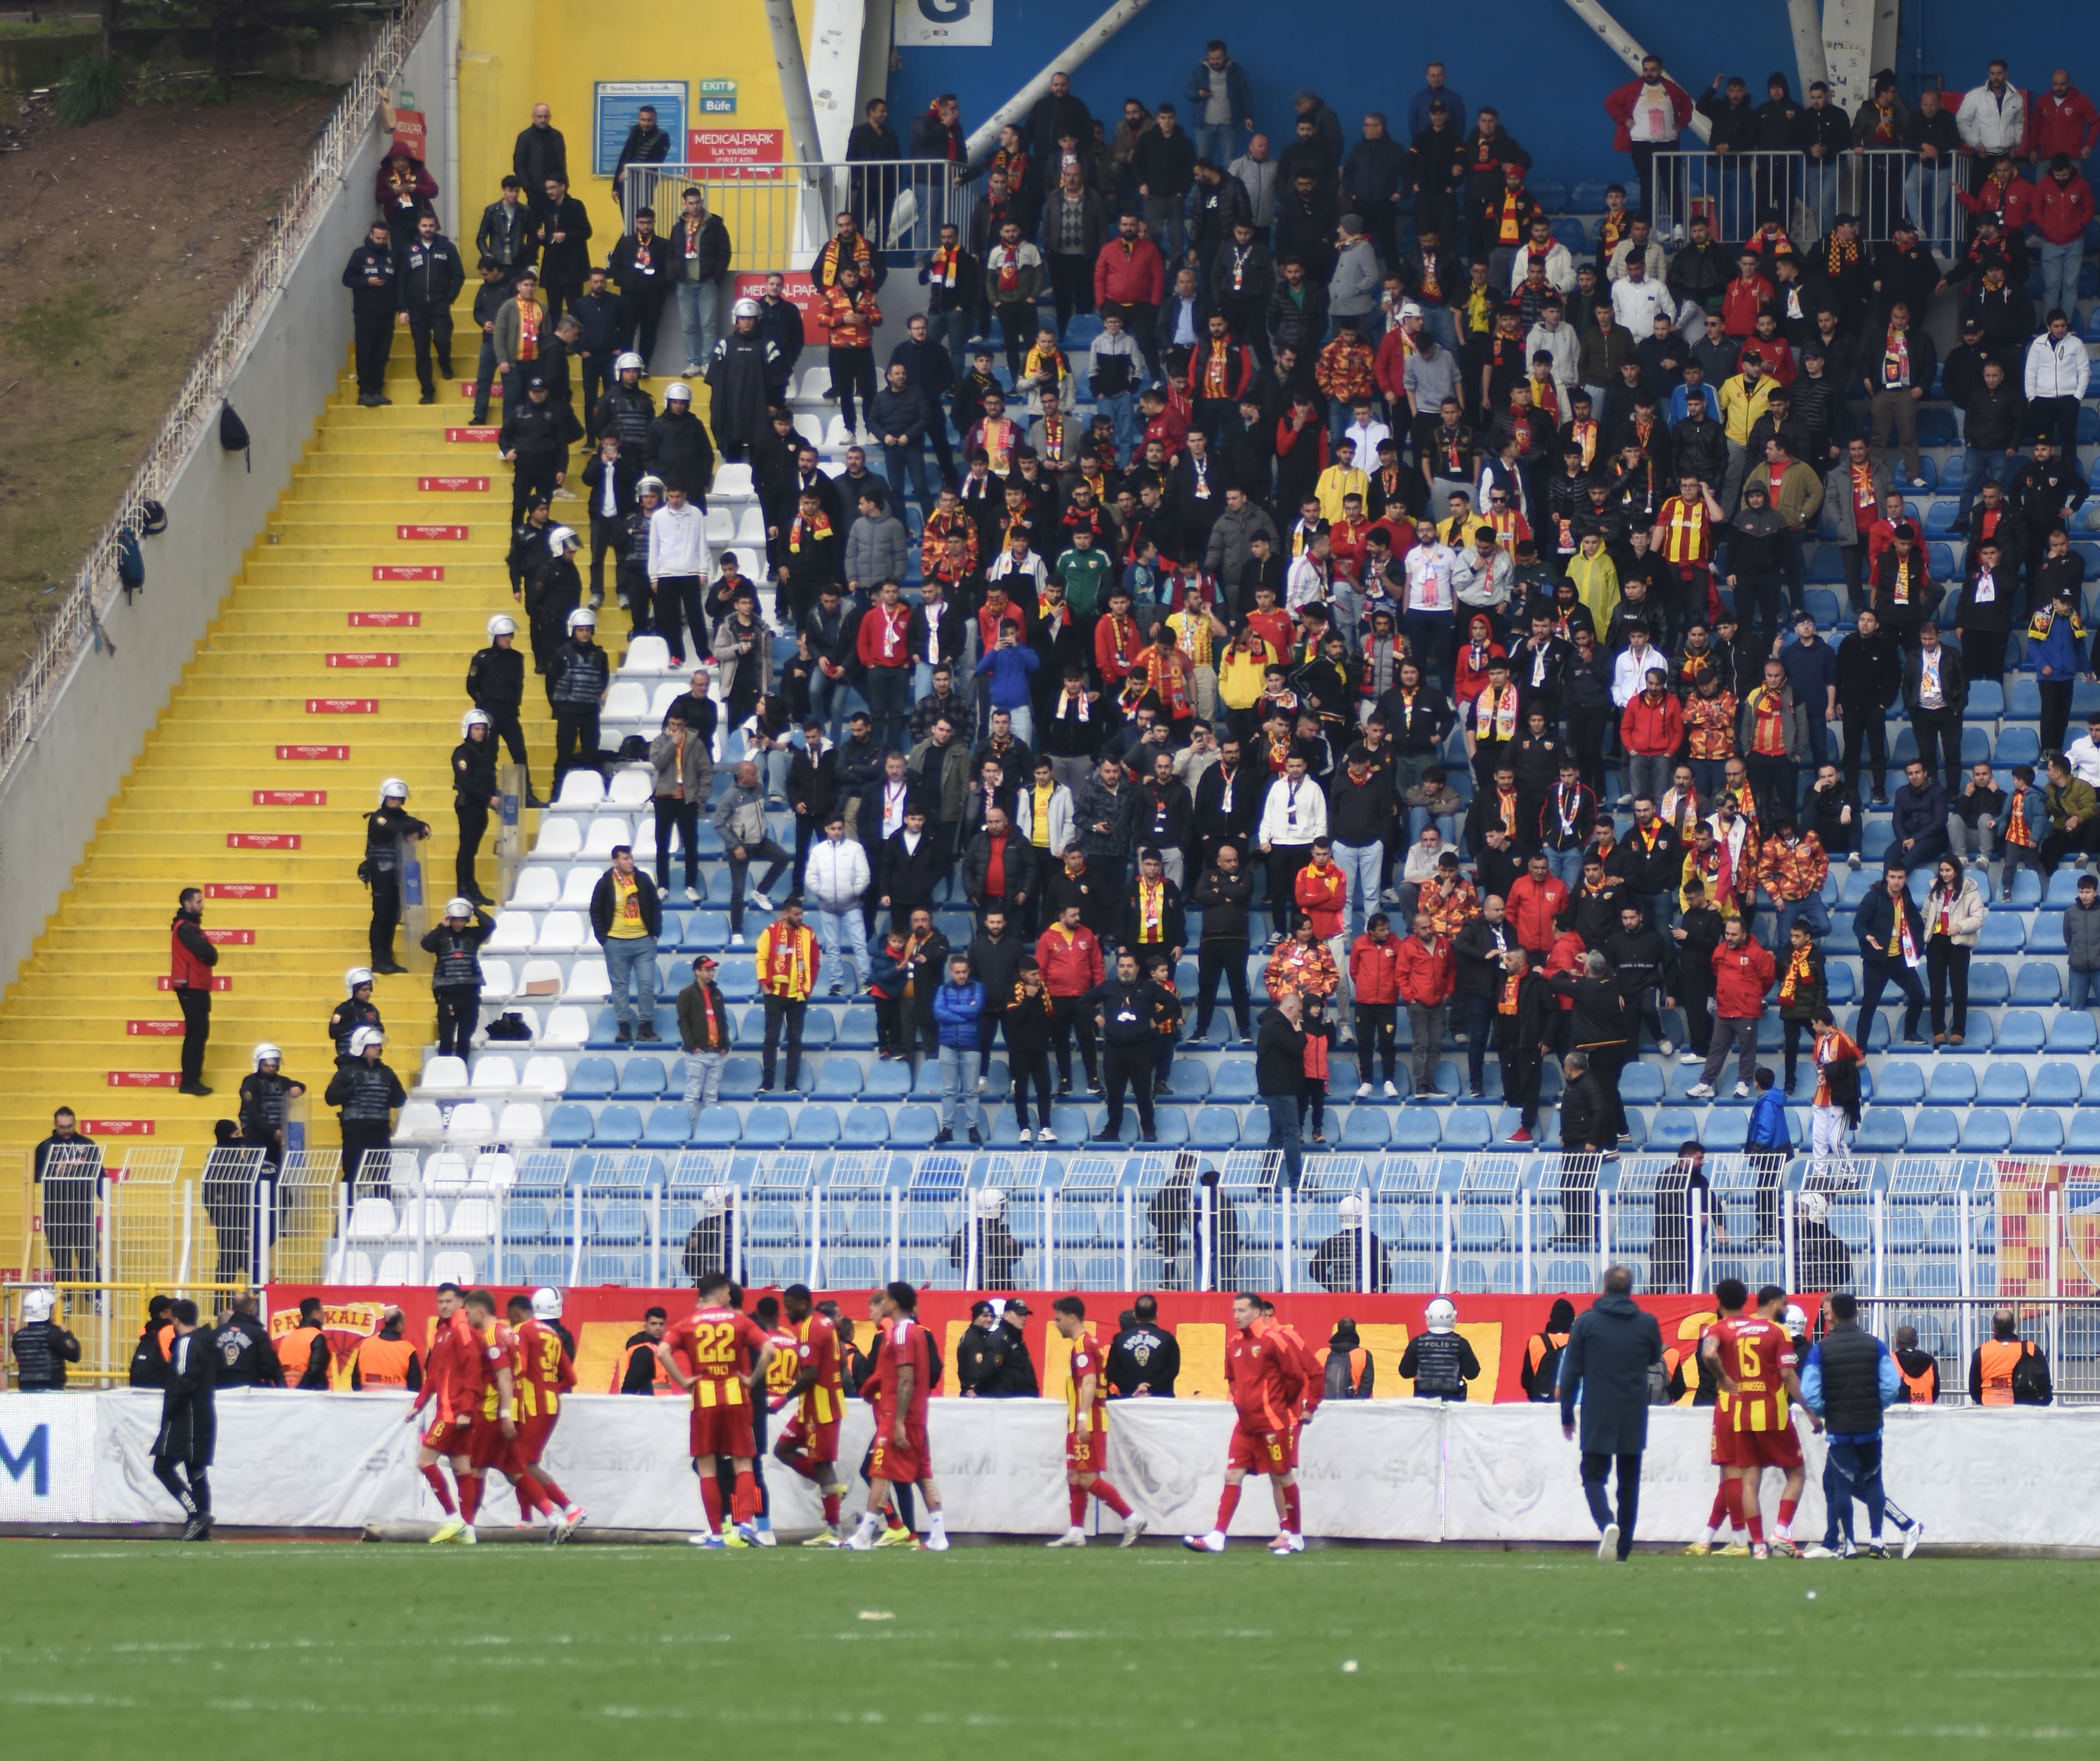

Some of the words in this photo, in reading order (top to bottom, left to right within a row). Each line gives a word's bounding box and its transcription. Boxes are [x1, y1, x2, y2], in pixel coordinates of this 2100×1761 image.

[703, 82, 727, 91] EXIT
[707, 100, 731, 111] Büfe
[695, 133, 774, 147] MEDICALPARK
[711, 147, 725, 156] İLK
[726, 148, 758, 156] YARDIM
[743, 283, 820, 297] MEDALPAR
[538, 1332, 562, 1370] 30
[696, 1323, 736, 1363] 22
[1425, 1340, 1450, 1349] POLİS
[1737, 1336, 1761, 1378] 15
[766, 1348, 798, 1384] 20
[807, 1432, 816, 1449] 4
[874, 1448, 884, 1465] 2
[1074, 1444, 1090, 1461] 33
